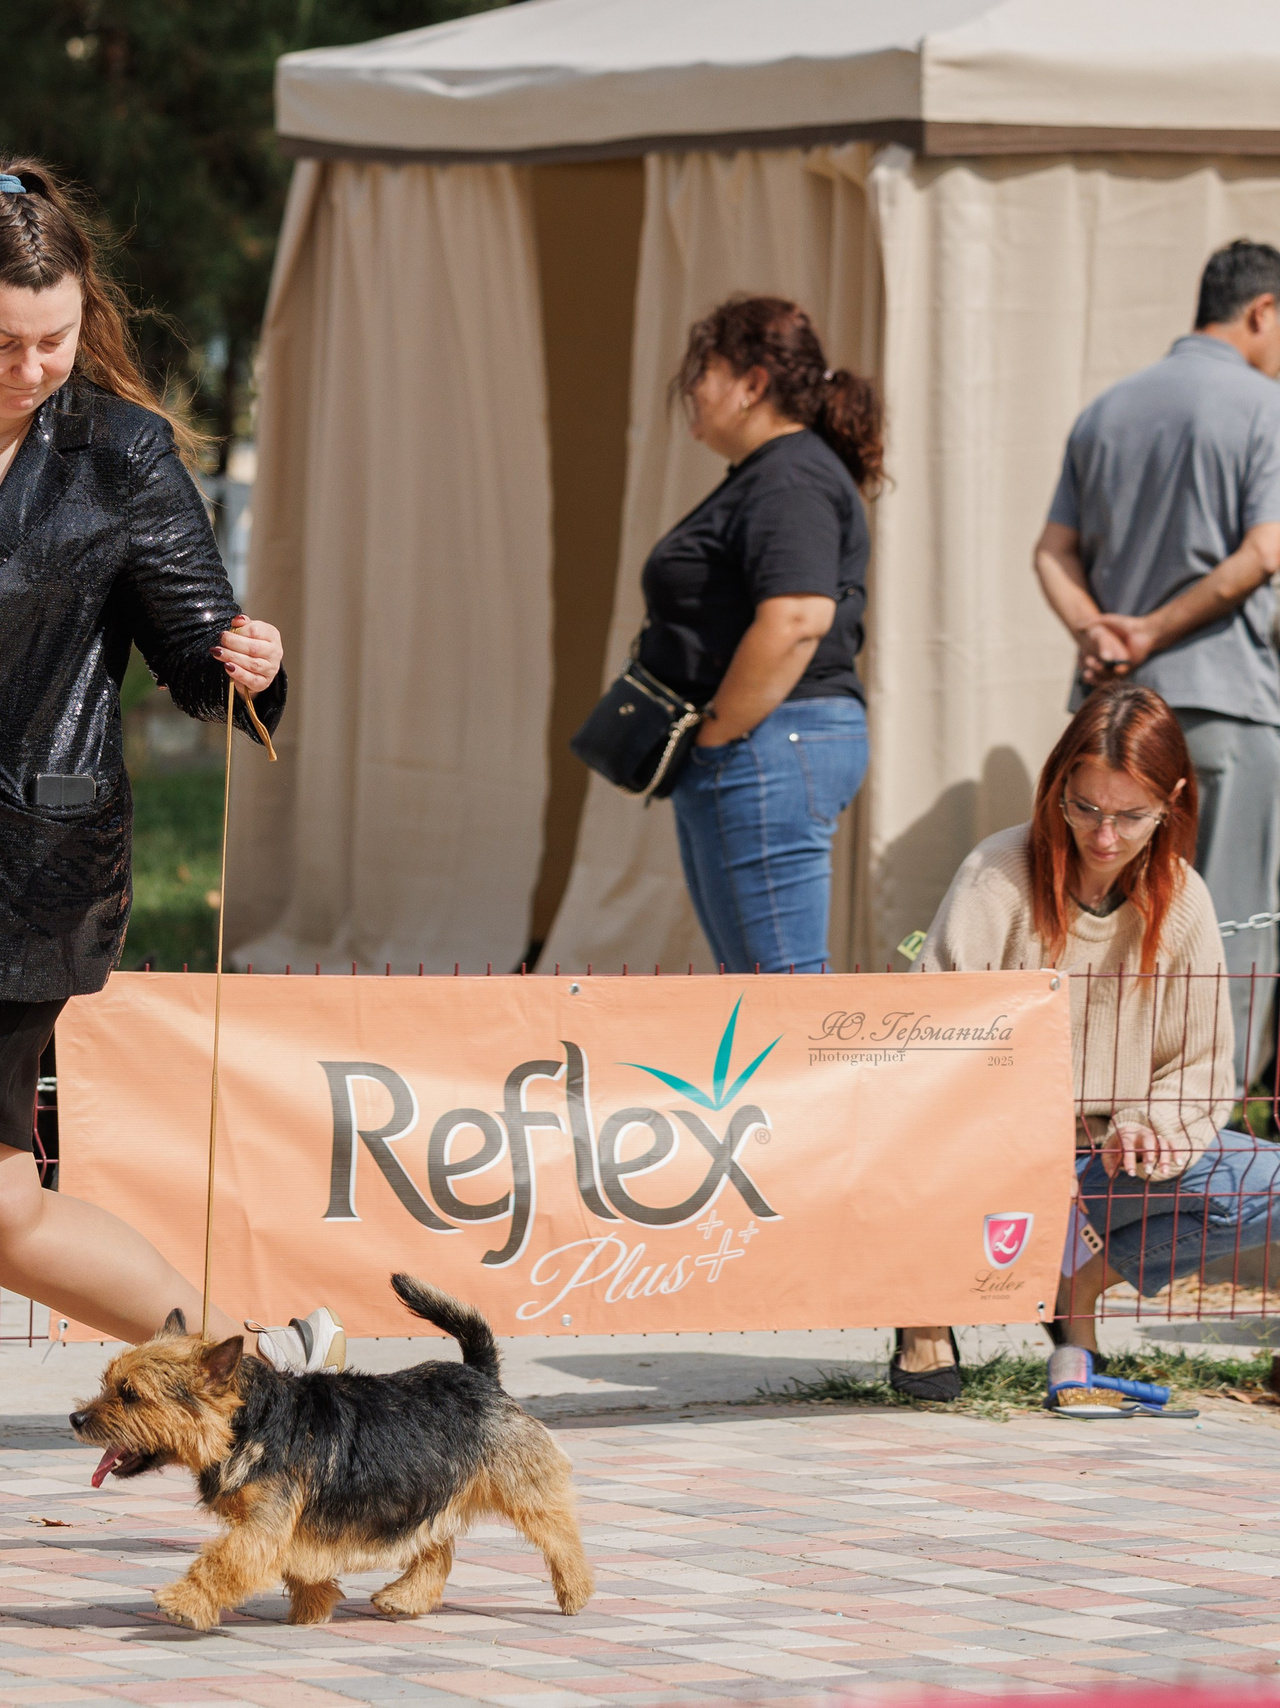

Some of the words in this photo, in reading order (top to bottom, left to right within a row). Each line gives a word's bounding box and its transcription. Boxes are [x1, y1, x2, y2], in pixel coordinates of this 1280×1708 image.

[317, 1040, 784, 1268] Reflex
[516, 1232, 694, 1320] Plus
[970, 1269, 1025, 1292] Lider
